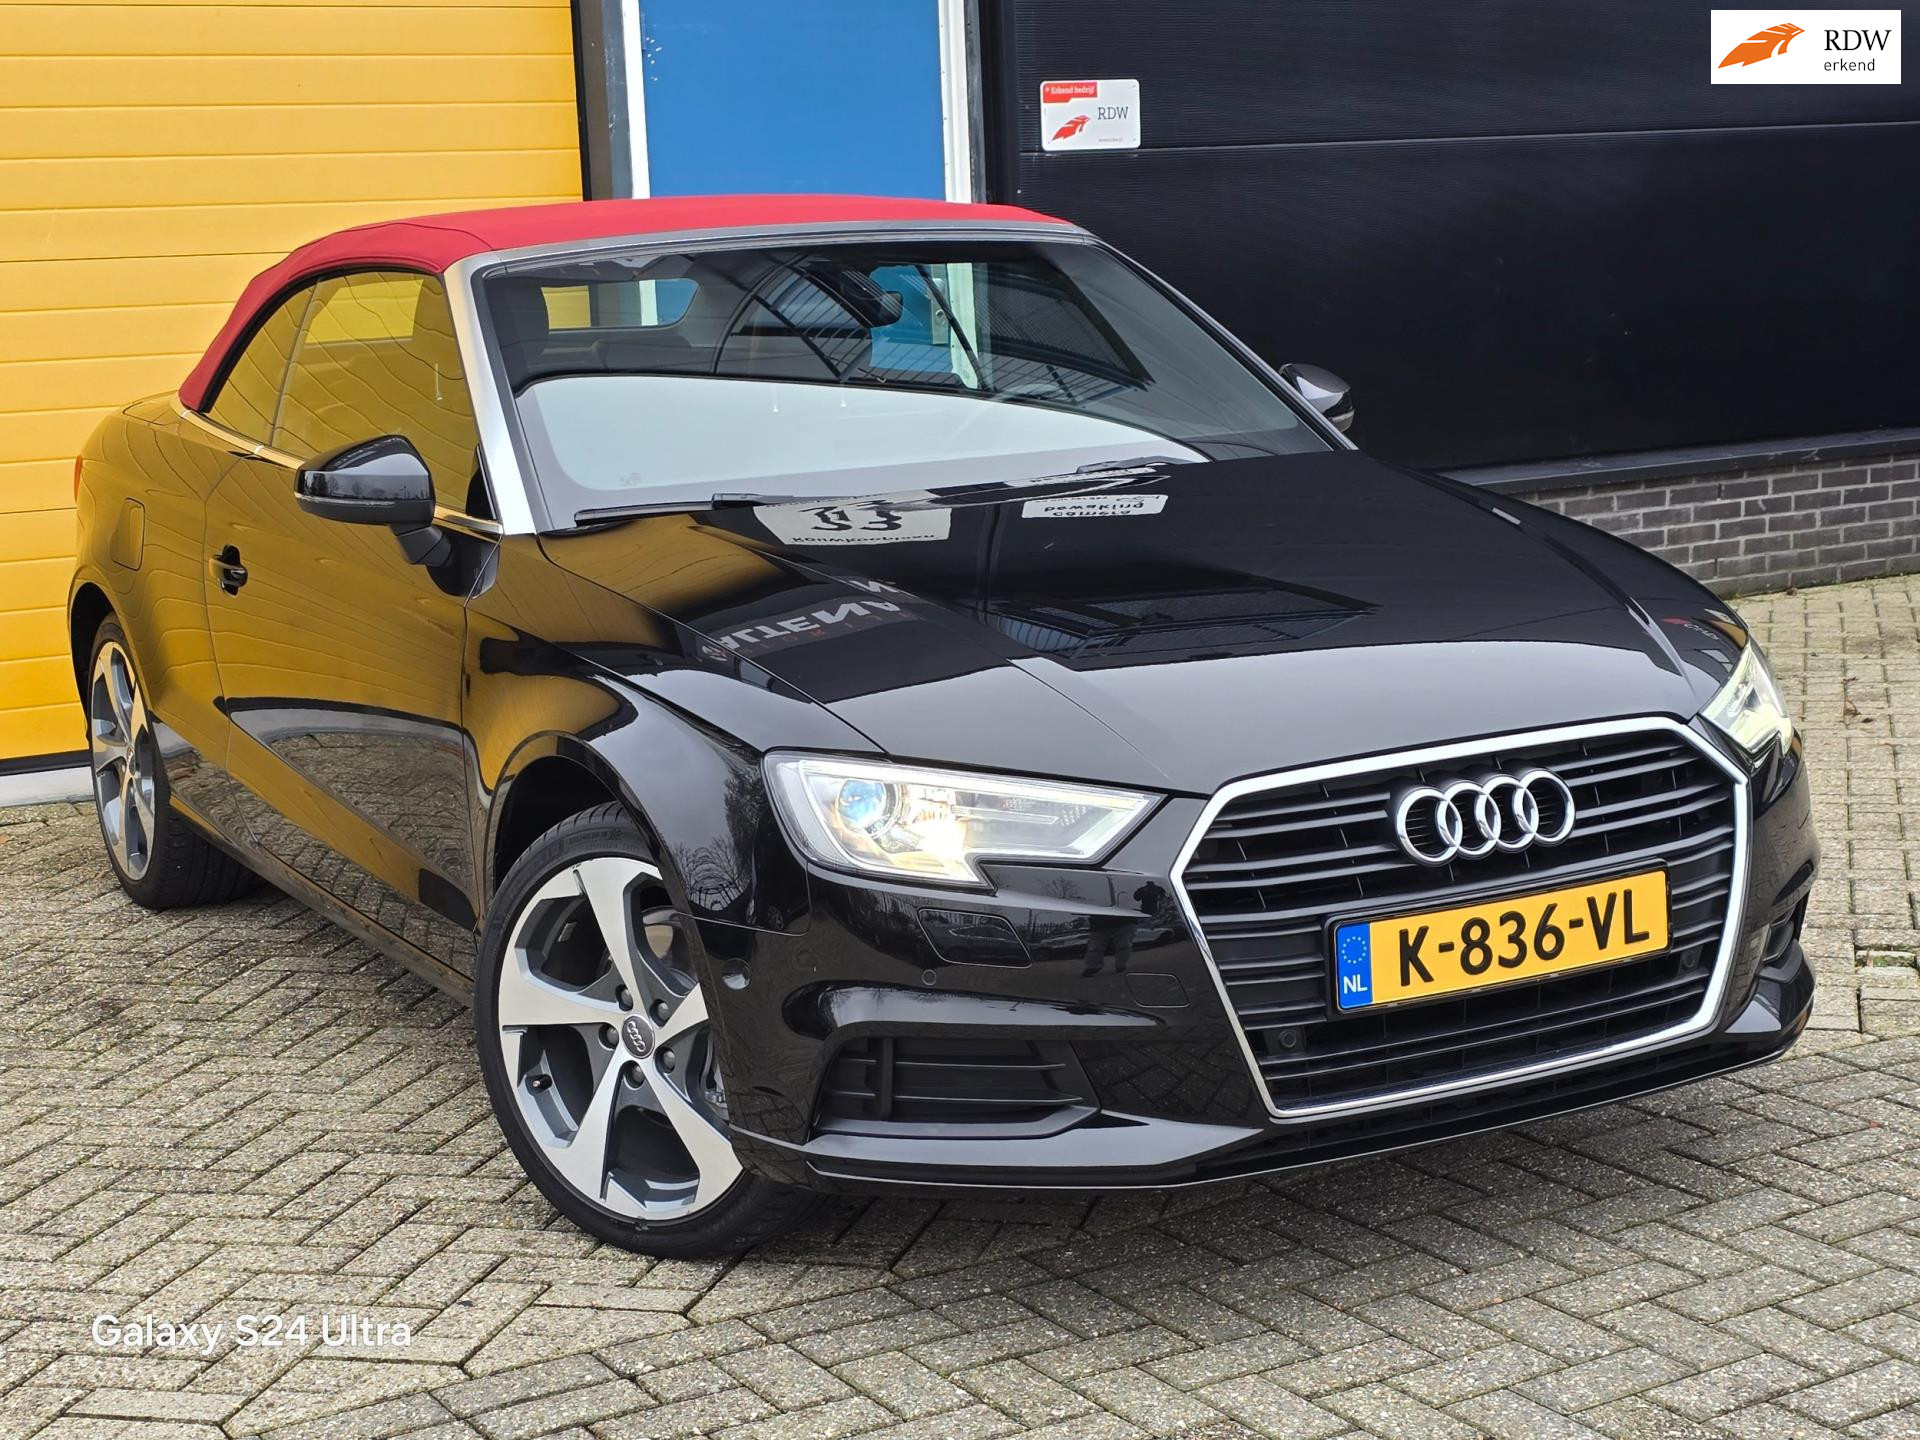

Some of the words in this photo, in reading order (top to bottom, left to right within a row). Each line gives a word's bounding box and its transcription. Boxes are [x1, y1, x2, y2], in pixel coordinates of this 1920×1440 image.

[1097, 106, 1129, 120] RDW
[1343, 973, 1369, 995] NL
[1399, 888, 1650, 987] K-836-VL
